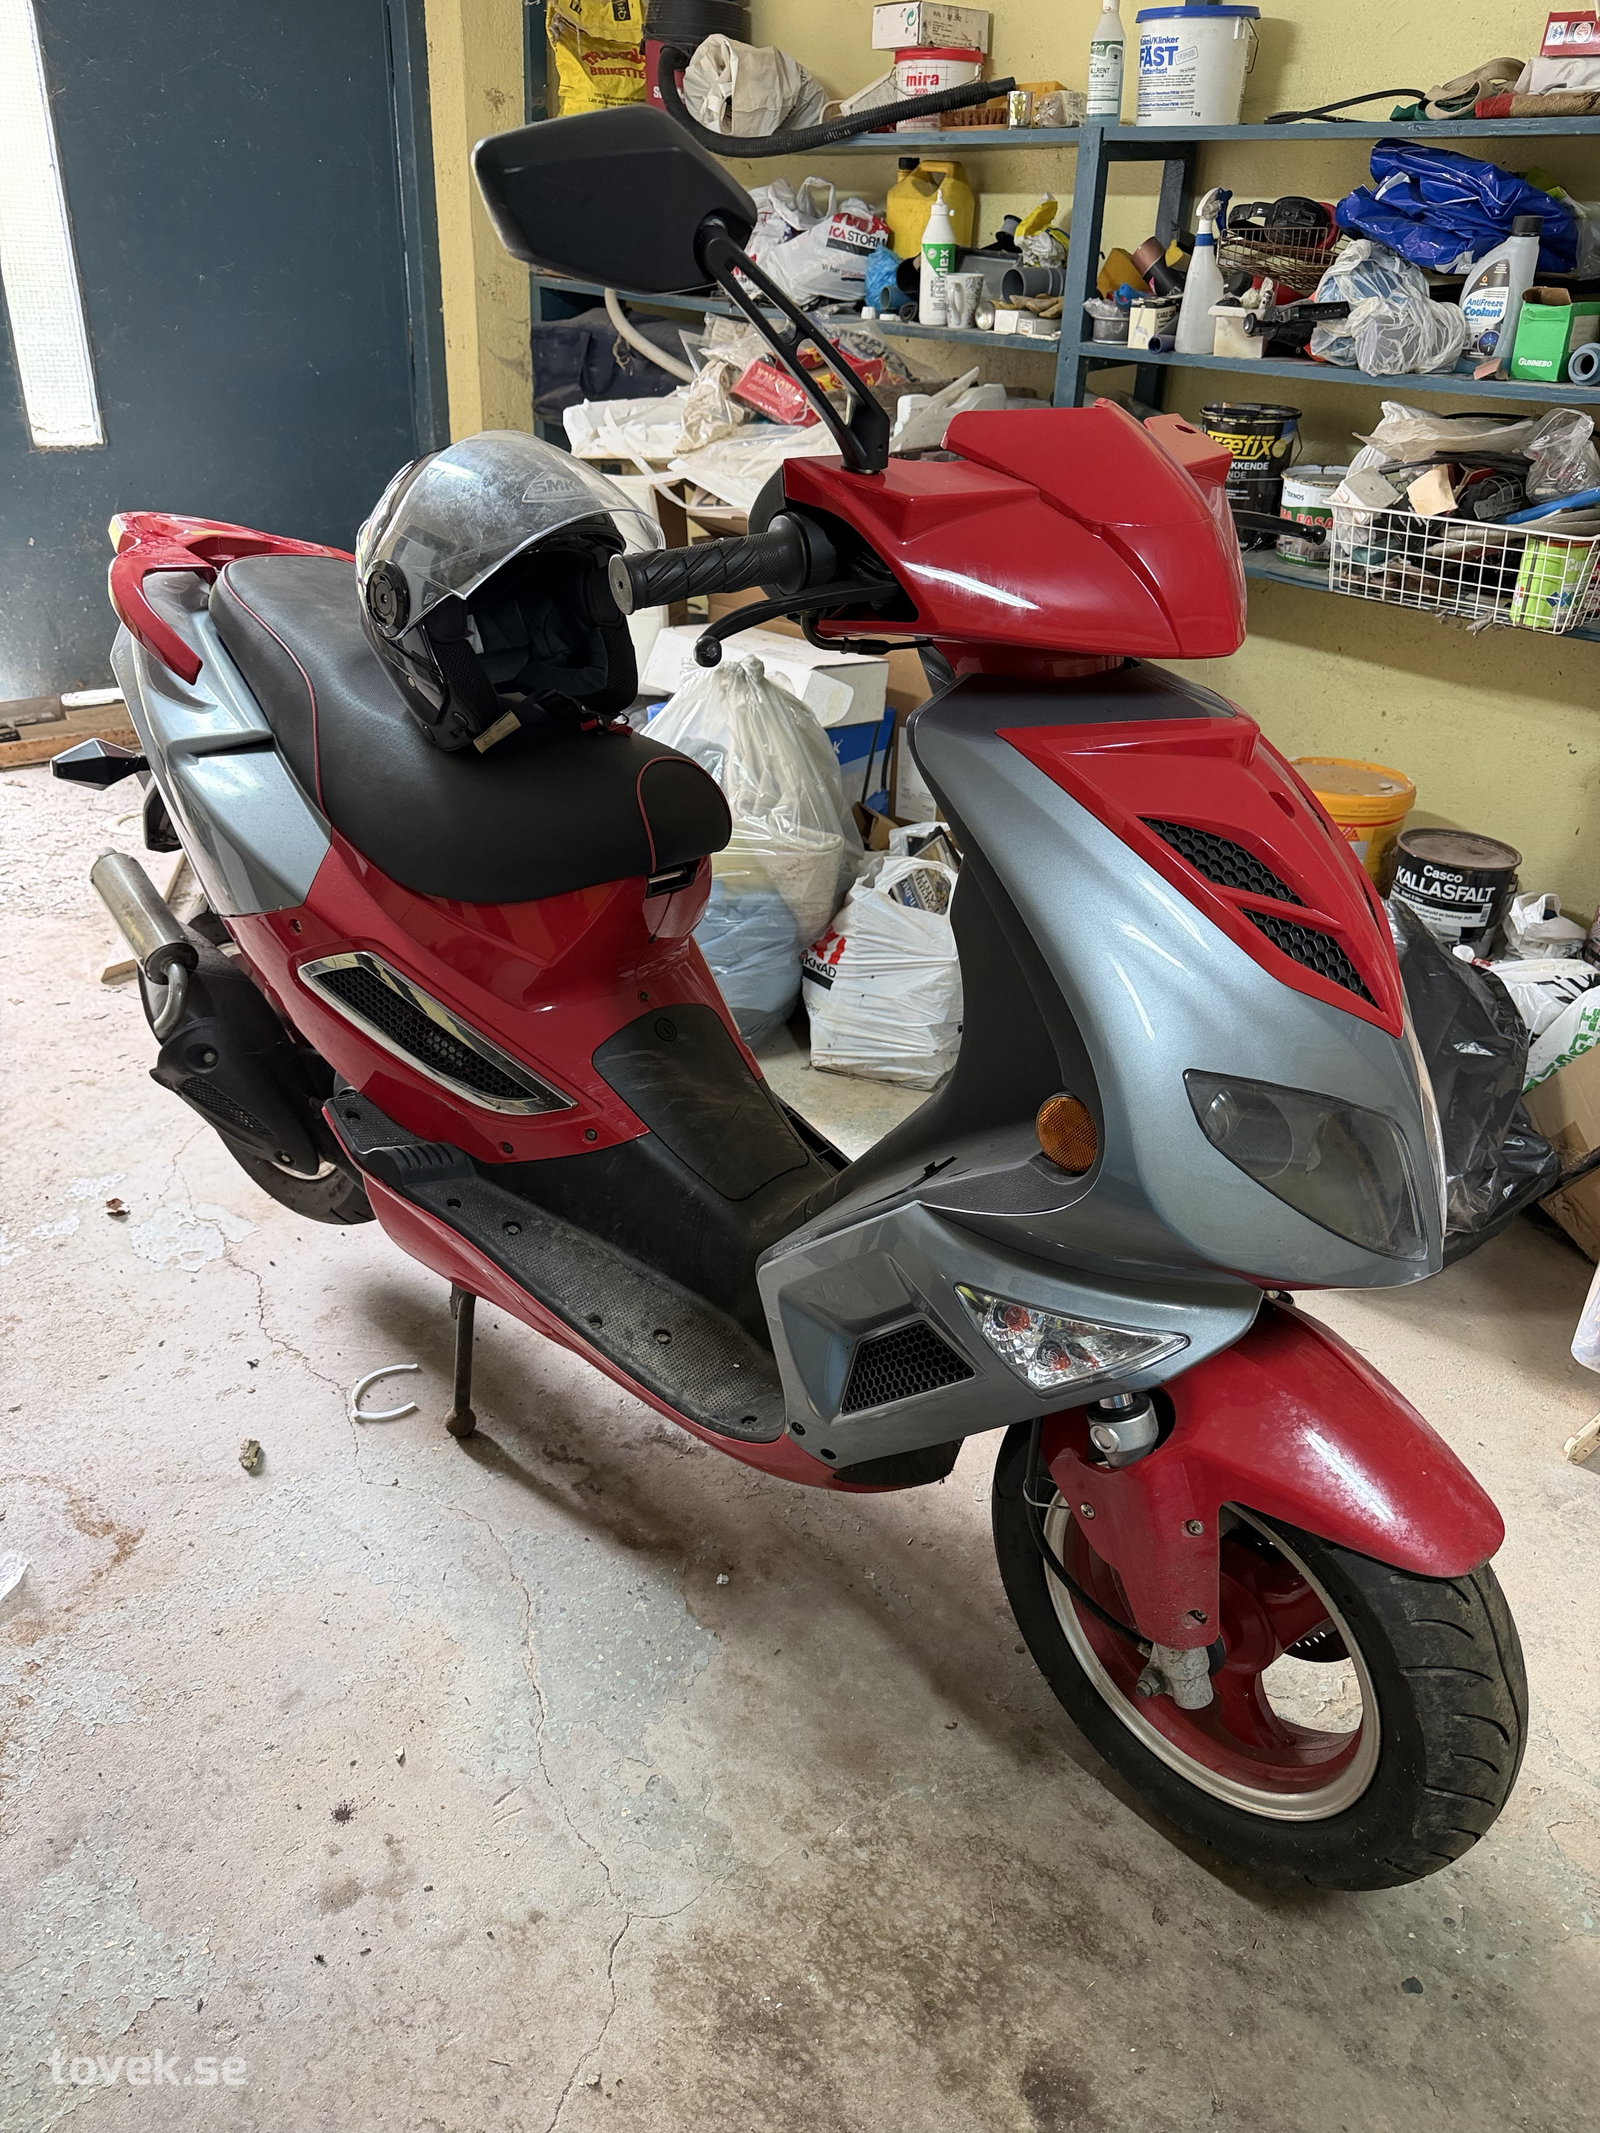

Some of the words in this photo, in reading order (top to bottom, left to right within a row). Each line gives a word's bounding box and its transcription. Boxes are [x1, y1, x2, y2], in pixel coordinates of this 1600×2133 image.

[1139, 45, 1179, 68] FÄST
[906, 71, 940, 87] mira
[828, 225, 847, 240] ICA
[847, 230, 887, 248] STORM
[1464, 305, 1502, 318] Coolant
[1466, 298, 1504, 307] AntiFreeze
[1518, 357, 1553, 368] GUNNEBO
[1423, 864, 1463, 884] Casco
[1395, 865, 1496, 903] KALLASFALT
